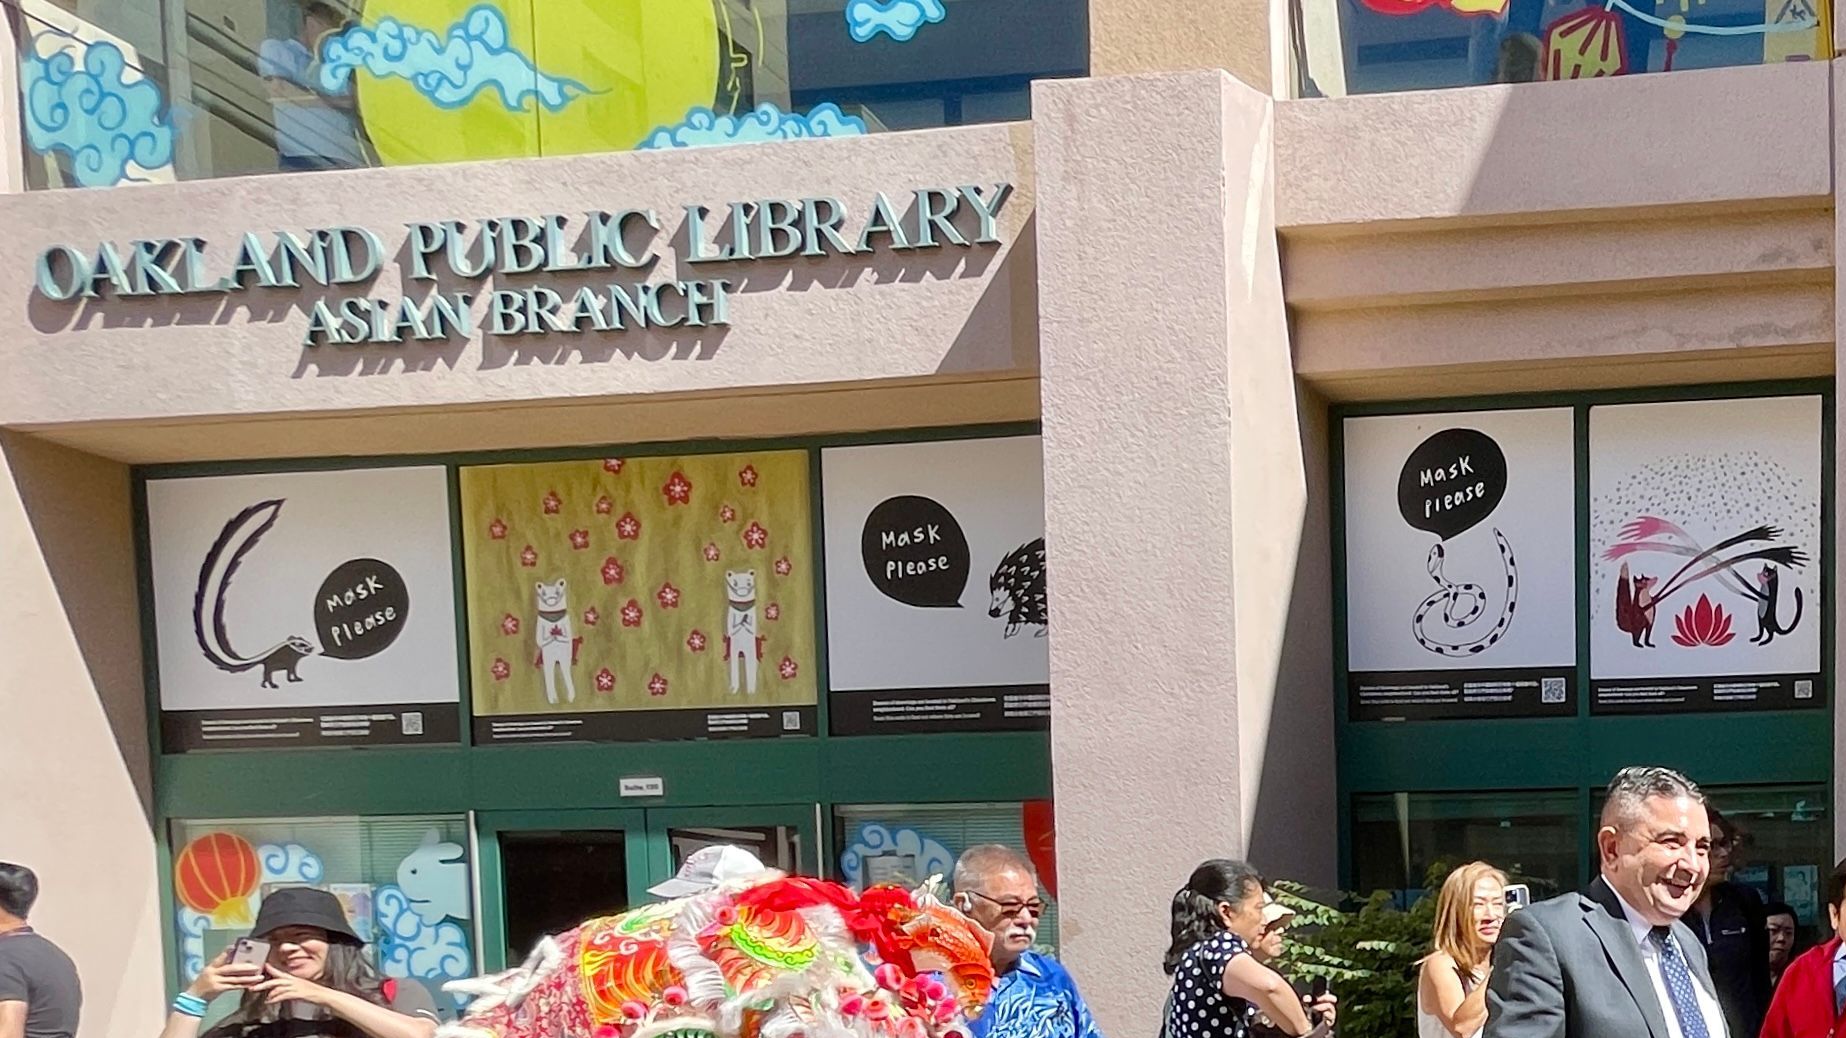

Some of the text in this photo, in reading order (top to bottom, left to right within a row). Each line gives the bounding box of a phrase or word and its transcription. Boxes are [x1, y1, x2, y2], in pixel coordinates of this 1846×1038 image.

[35, 182, 1014, 300] OAKLAND PUBLIC LIBRARY
[302, 279, 732, 346] ASIAN BRANCH
[1420, 455, 1475, 488] Mask
[881, 523, 941, 551] Mask
[886, 555, 950, 580] Please
[326, 575, 385, 613] Mask
[331, 606, 397, 647] Please
